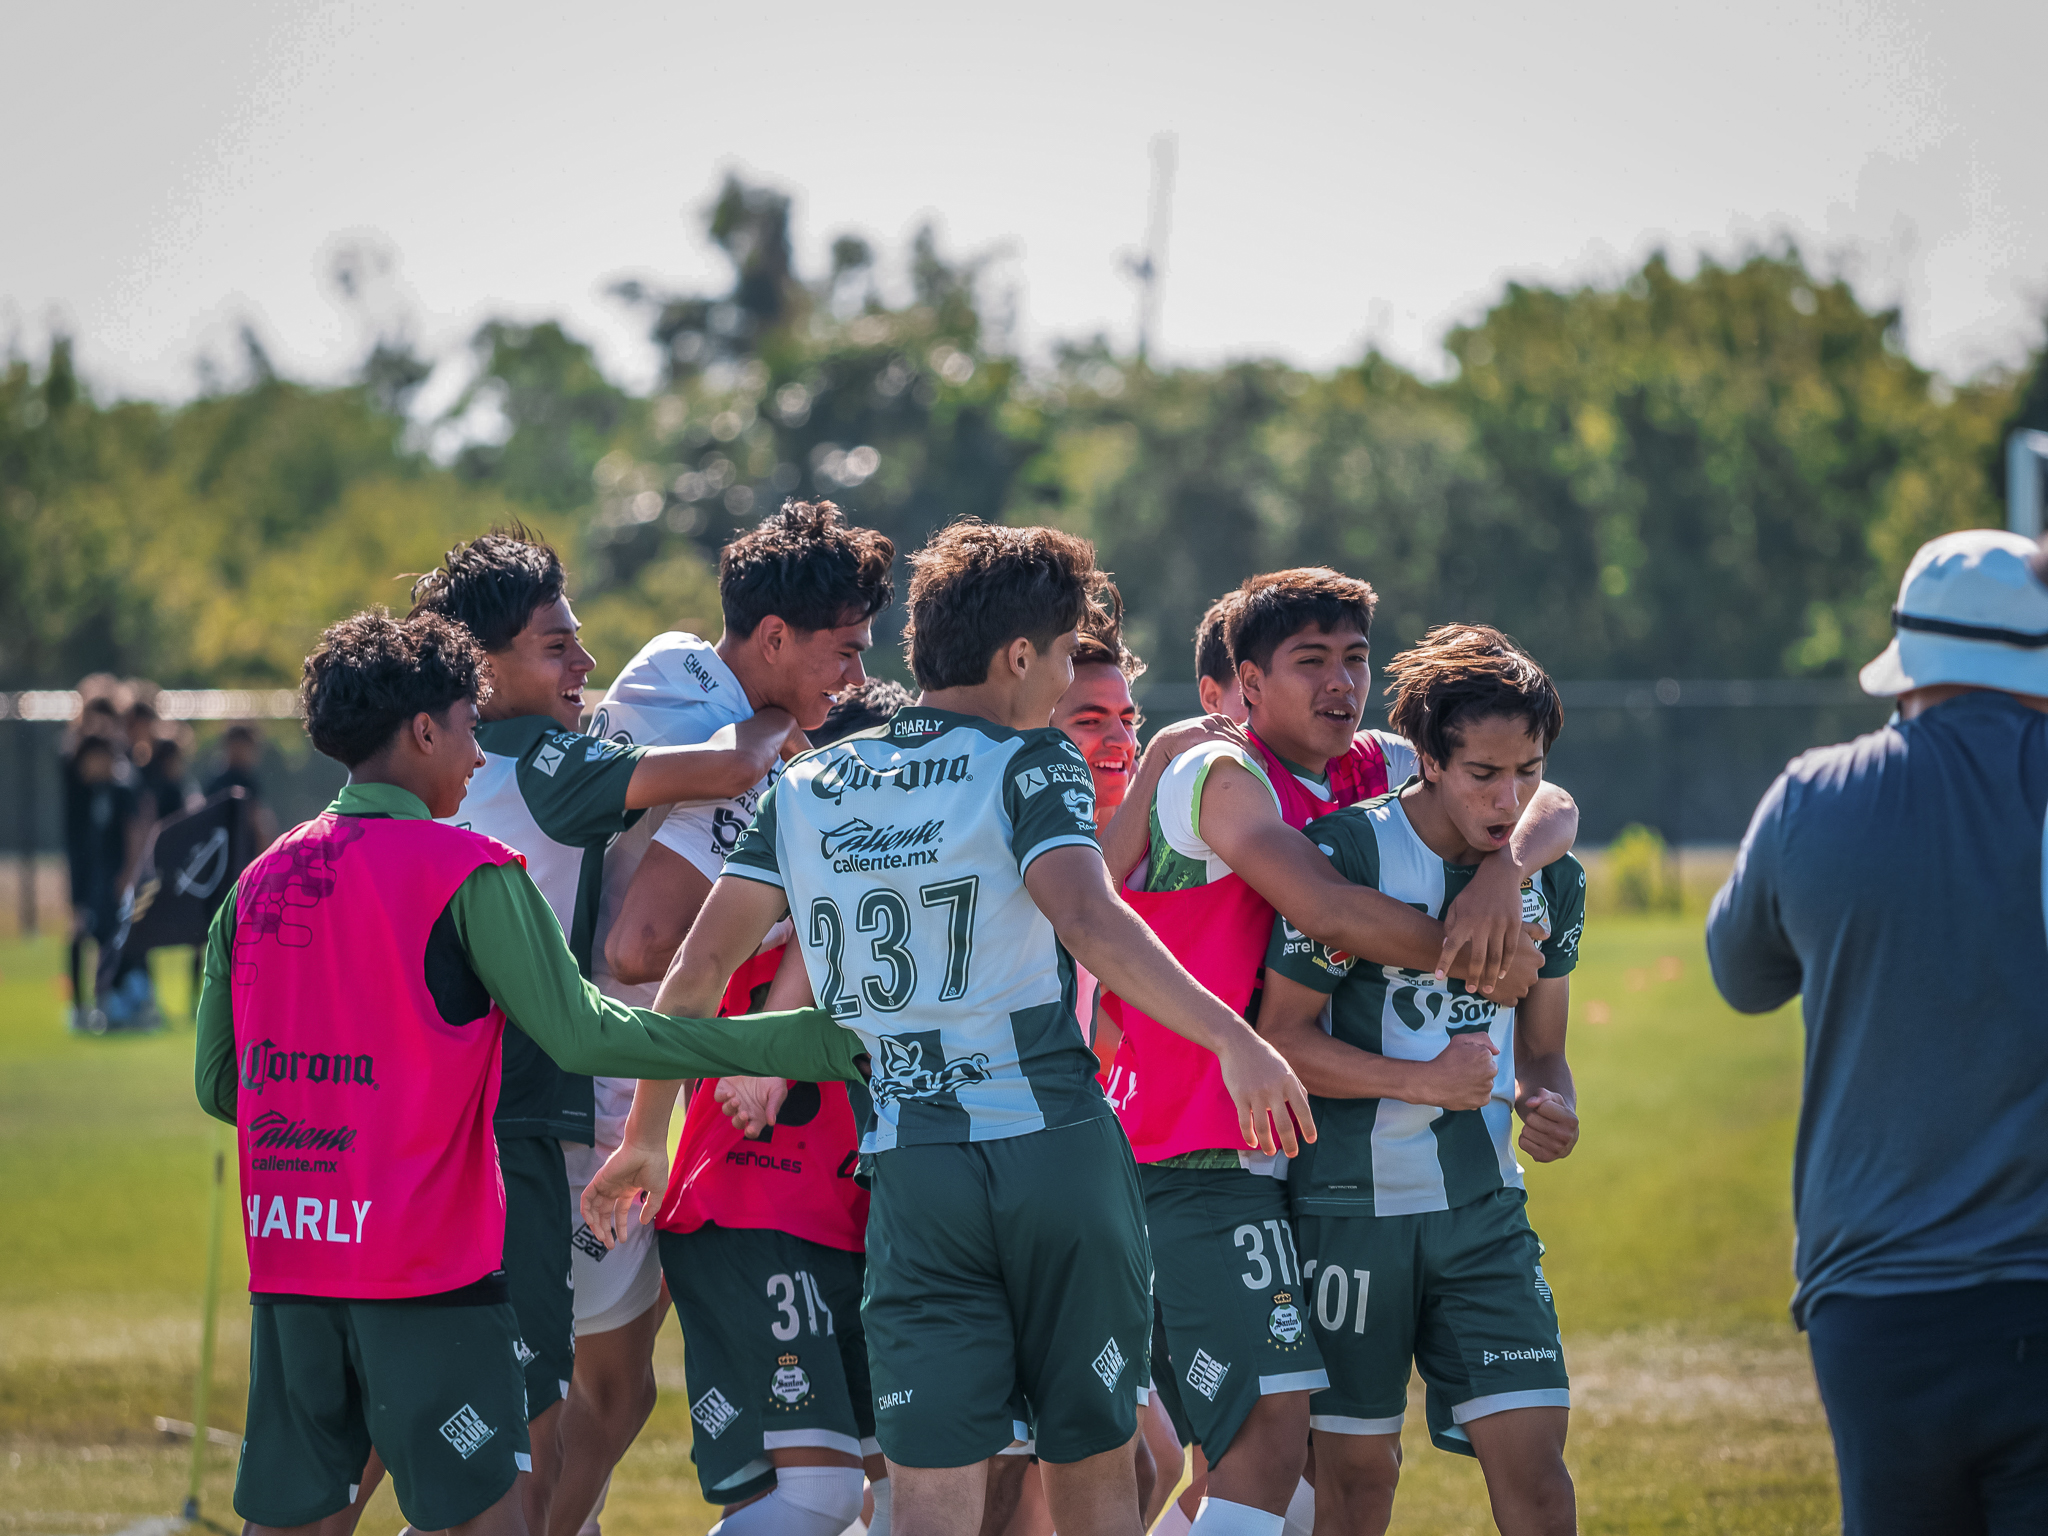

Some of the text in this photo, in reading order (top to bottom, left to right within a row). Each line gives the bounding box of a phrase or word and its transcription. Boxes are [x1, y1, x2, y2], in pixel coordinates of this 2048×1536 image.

[685, 653, 719, 693] CHARLY
[894, 719, 944, 735] CHARLY
[811, 753, 970, 806] Corona
[1047, 763, 1087, 777] GRUPO
[818, 817, 945, 860] Caliente
[833, 848, 939, 874] caliente.mx
[1522, 902, 1540, 913] antos
[810, 875, 979, 1021] 237
[240, 1038, 375, 1096] Corona
[247, 1109, 357, 1154] Caliente
[251, 1156, 338, 1173] caliente.mx
[1303, 1259, 1371, 1335] 01
[1094, 1339, 1117, 1375] CITY
[1102, 1351, 1124, 1388] CLUB
[1188, 1350, 1211, 1386] CITY
[1501, 1347, 1558, 1363] Totalplay
[1198, 1359, 1223, 1397] CLUB
[691, 1389, 721, 1421] CITY
[702, 1401, 735, 1434] CLUB
[878, 1389, 913, 1411] CHARLY
[442, 1405, 476, 1440] CITY
[452, 1419, 489, 1453] CLUB
